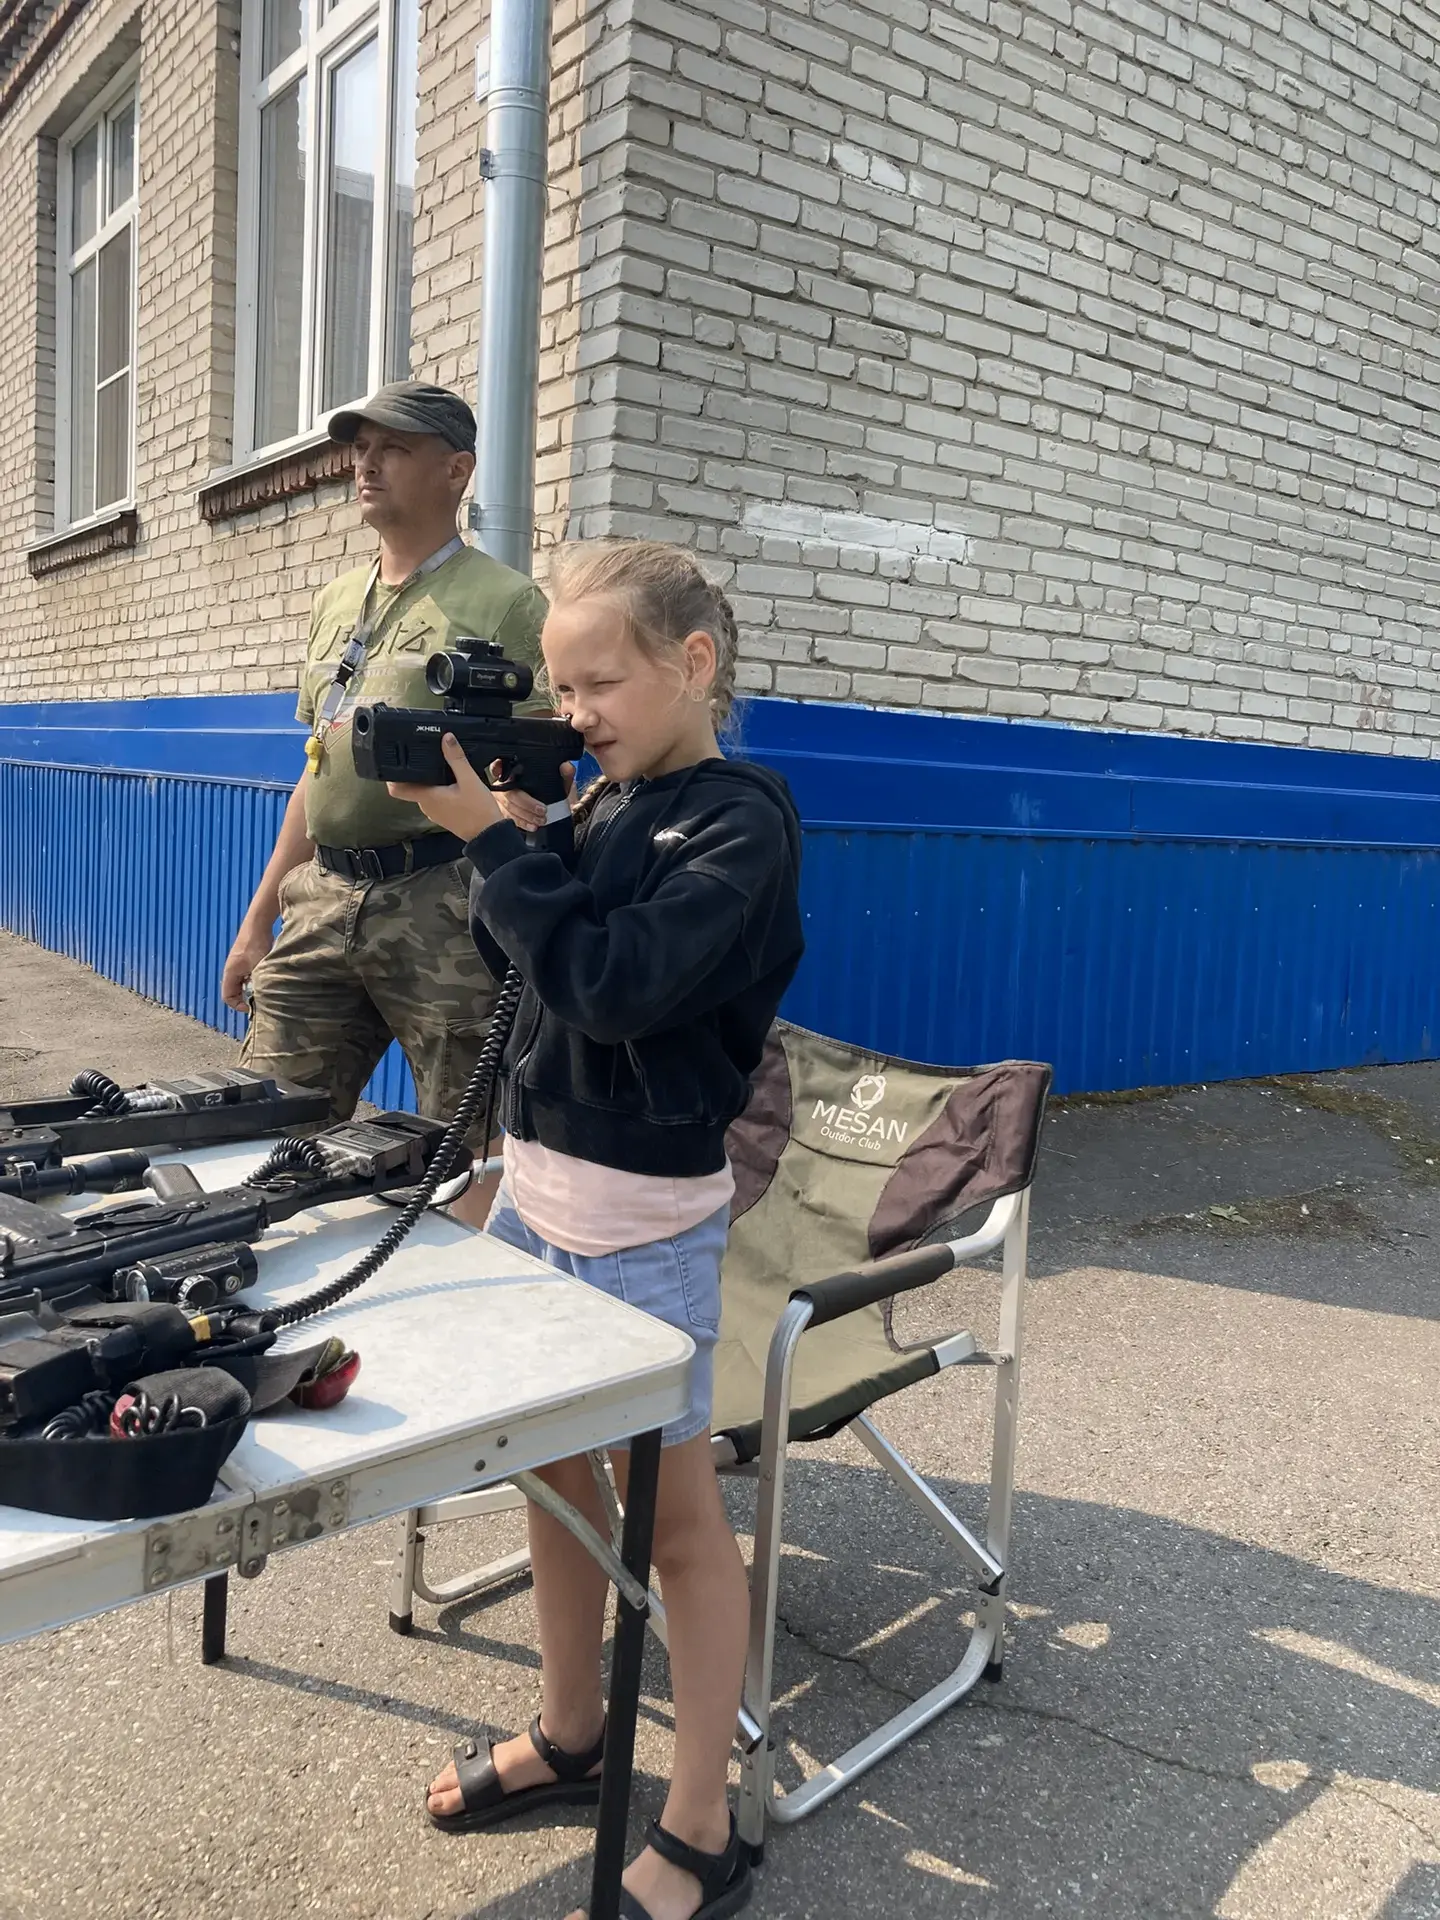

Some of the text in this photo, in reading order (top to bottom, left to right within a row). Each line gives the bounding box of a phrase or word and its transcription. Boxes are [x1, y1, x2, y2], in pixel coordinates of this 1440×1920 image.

[416, 725, 441, 733] ЖНЕЦ
[811, 1099, 908, 1143] MESAN
[820, 1126, 881, 1151] Outdor Club
